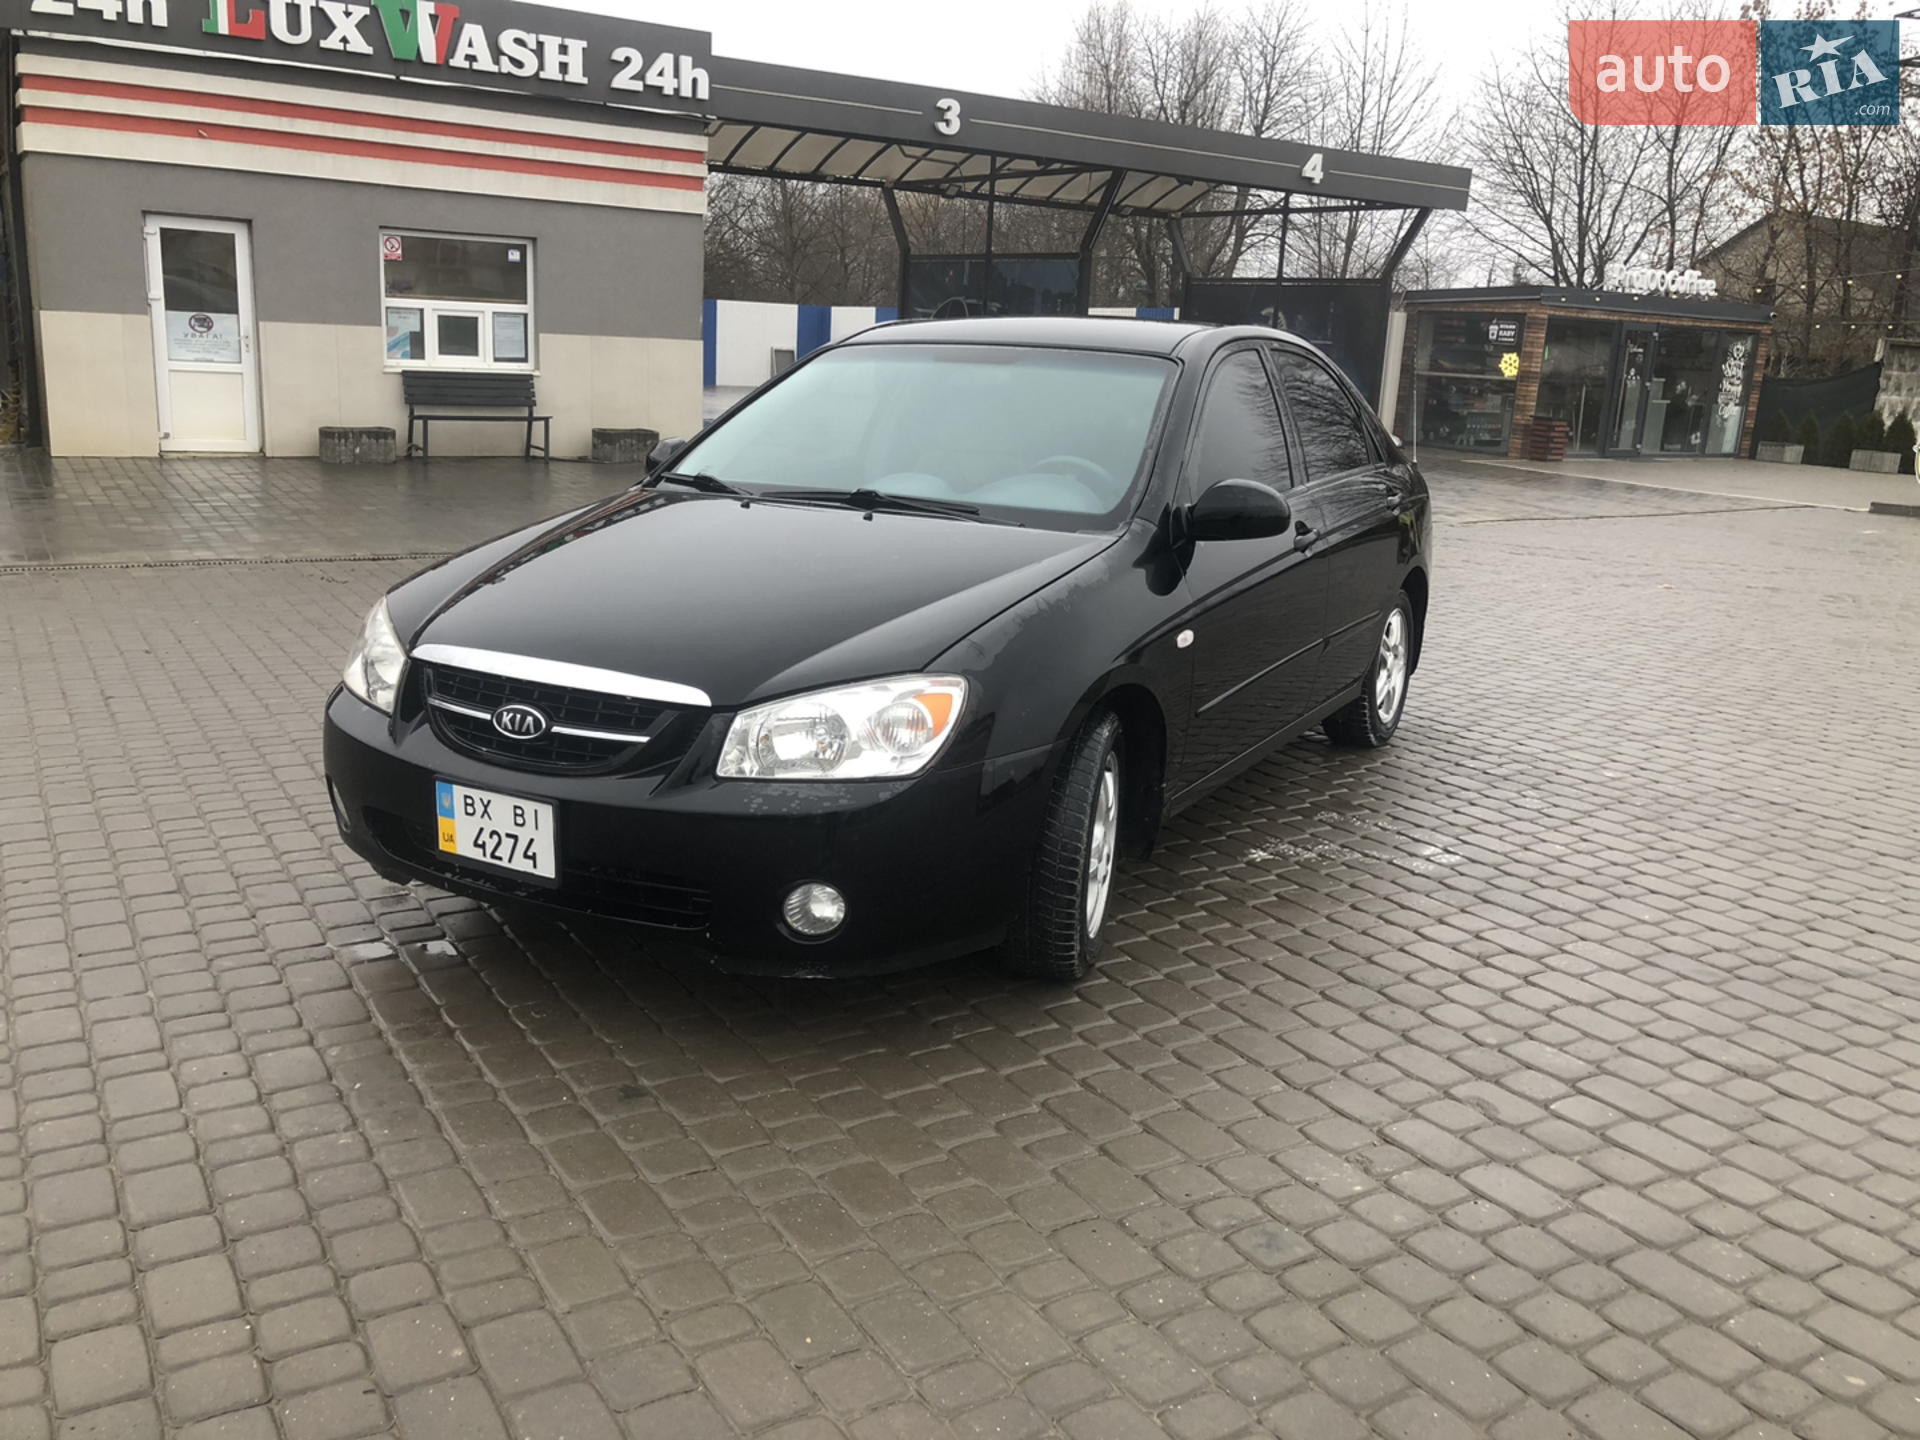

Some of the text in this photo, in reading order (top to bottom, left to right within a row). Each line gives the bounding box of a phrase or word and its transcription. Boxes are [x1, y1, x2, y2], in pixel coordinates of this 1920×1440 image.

[610, 46, 710, 100] 24h
[933, 98, 961, 136] 3
[1301, 152, 1324, 184] 4
[501, 711, 535, 734] KIA
[463, 794, 539, 831] BX BI
[442, 832, 455, 844] UA
[473, 827, 537, 869] 4274
